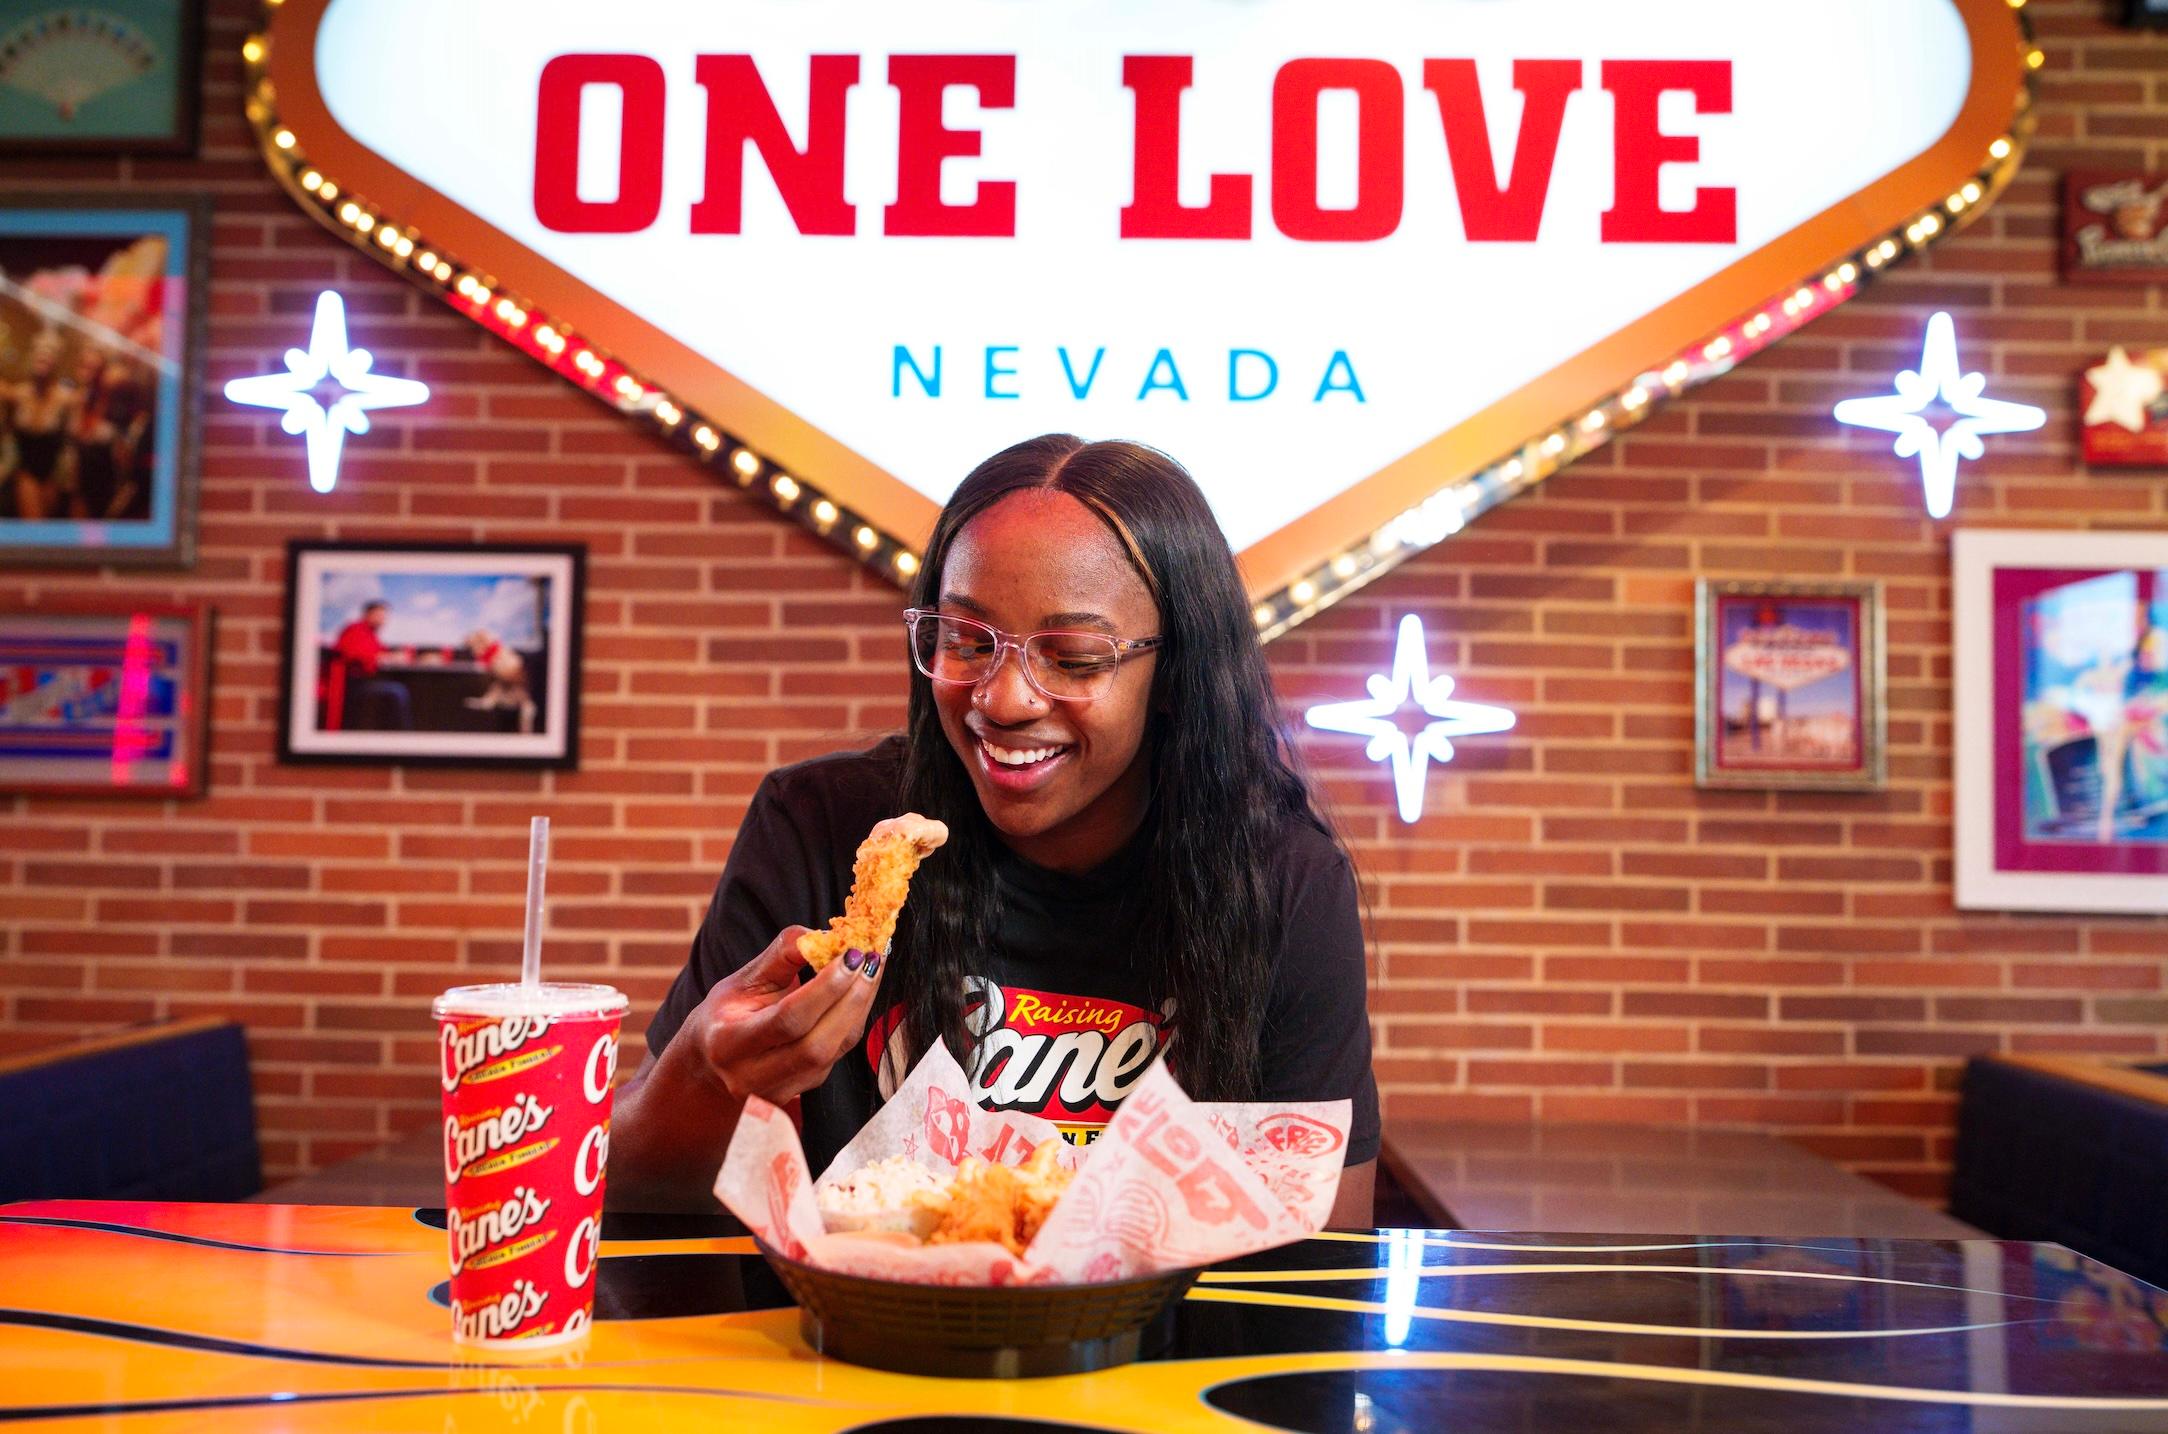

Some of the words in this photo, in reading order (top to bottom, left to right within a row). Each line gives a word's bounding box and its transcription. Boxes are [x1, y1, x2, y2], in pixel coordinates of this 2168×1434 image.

[532, 53, 1018, 237] ONE
[1120, 55, 1738, 244] LOVE
[891, 345, 1367, 404] NEVADA
[1008, 994, 1124, 1034] Raising
[444, 1092, 554, 1185] Cane's
[447, 1186, 552, 1276] Cane's
